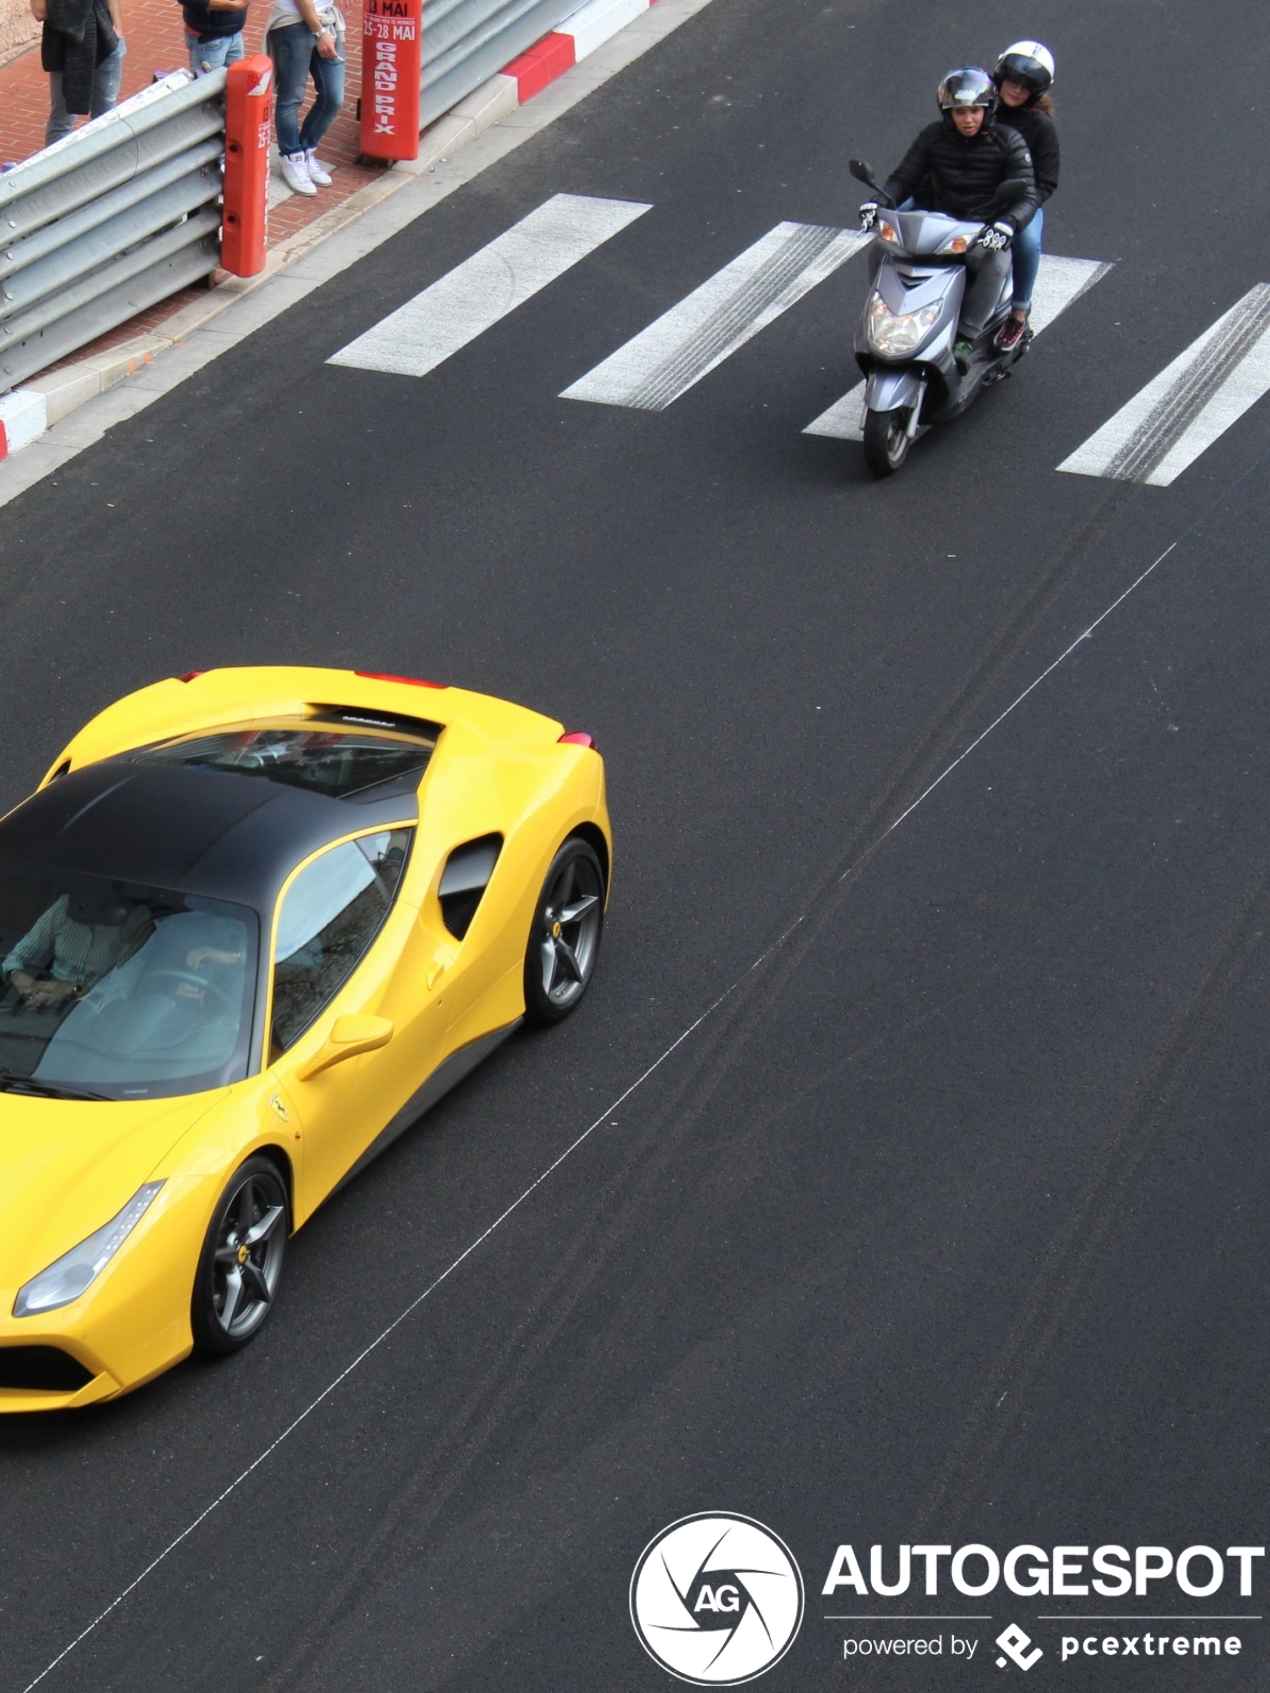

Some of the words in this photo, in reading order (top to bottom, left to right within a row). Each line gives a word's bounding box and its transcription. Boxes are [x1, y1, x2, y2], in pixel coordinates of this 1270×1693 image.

[382, 1, 408, 17] MAI
[364, 20, 389, 39] 25-28
[393, 25, 415, 41] MAI
[374, 42, 397, 91] GRAND
[374, 94, 395, 135] PRIX
